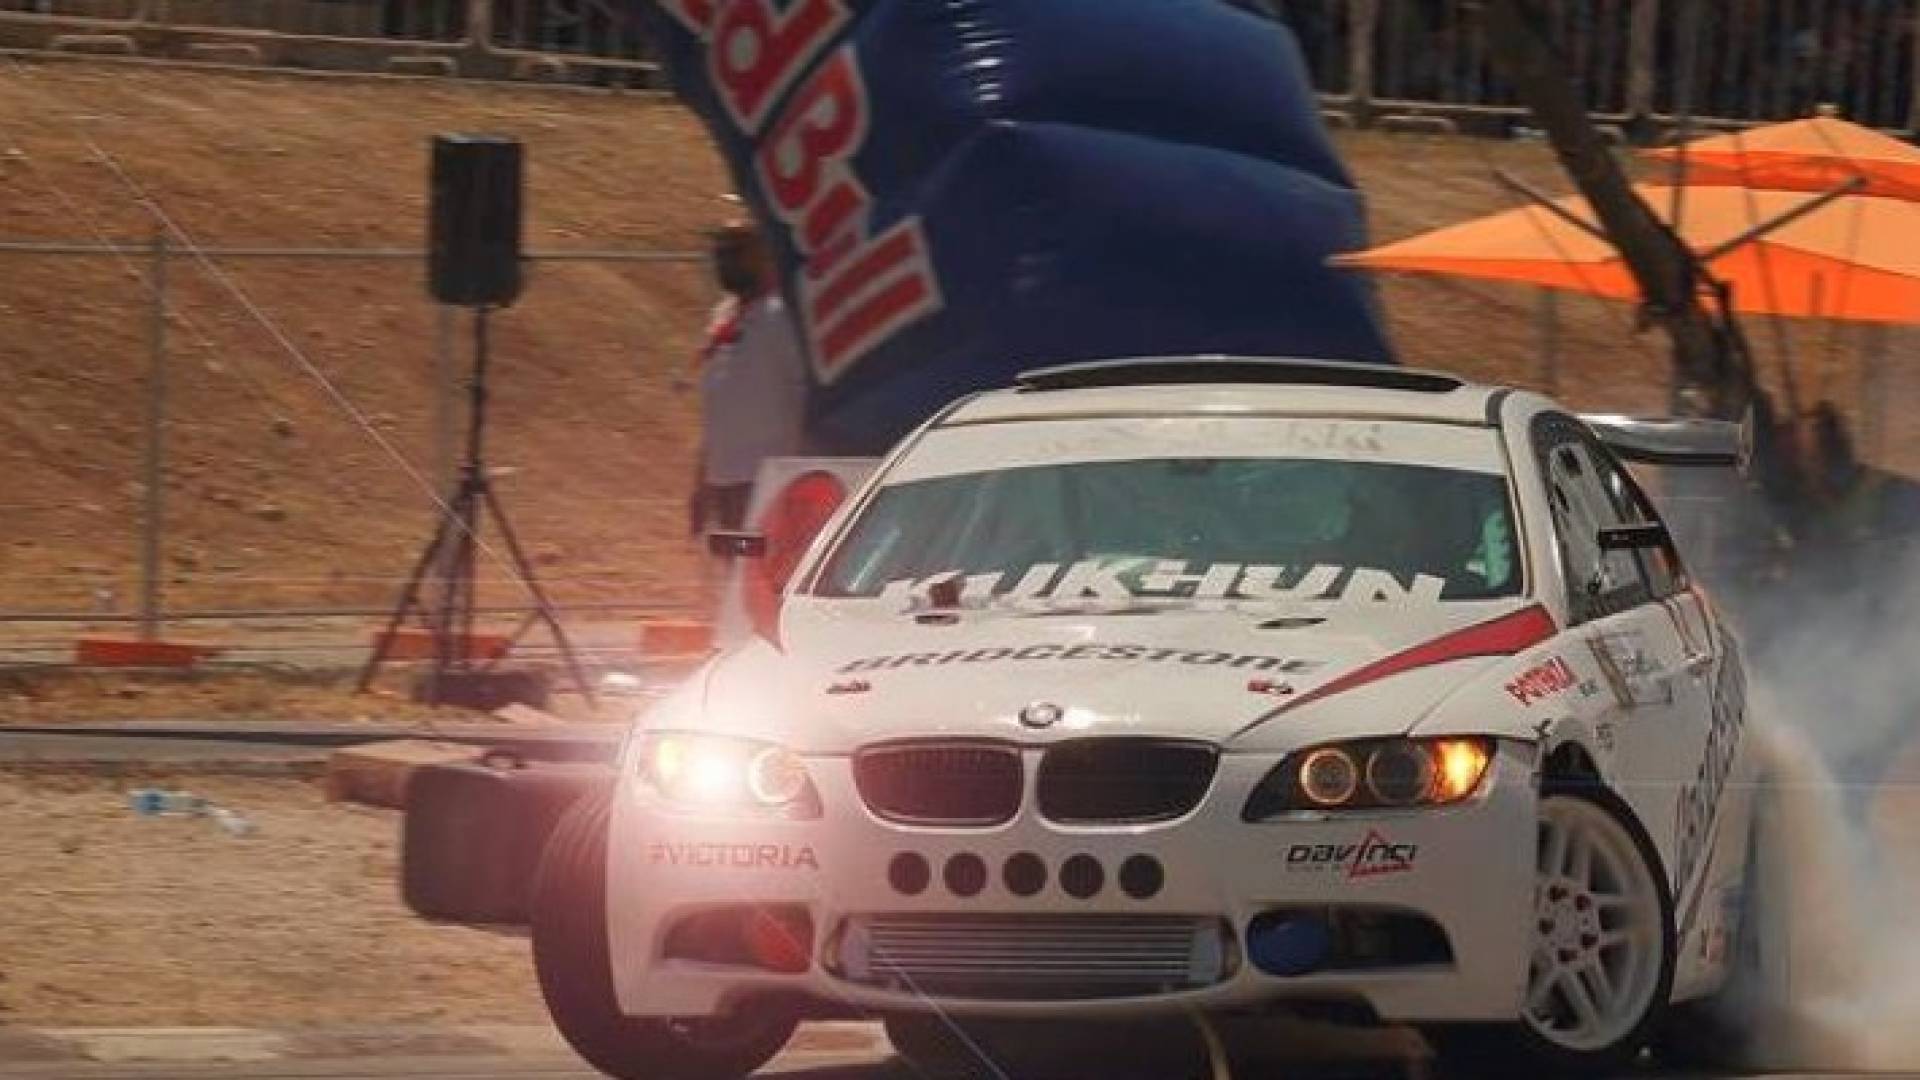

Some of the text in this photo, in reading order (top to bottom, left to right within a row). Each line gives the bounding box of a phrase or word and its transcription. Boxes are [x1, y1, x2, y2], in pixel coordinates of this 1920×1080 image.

[656, 0, 946, 383] d Bull
[837, 643, 1322, 675] BRIDGESTONE
